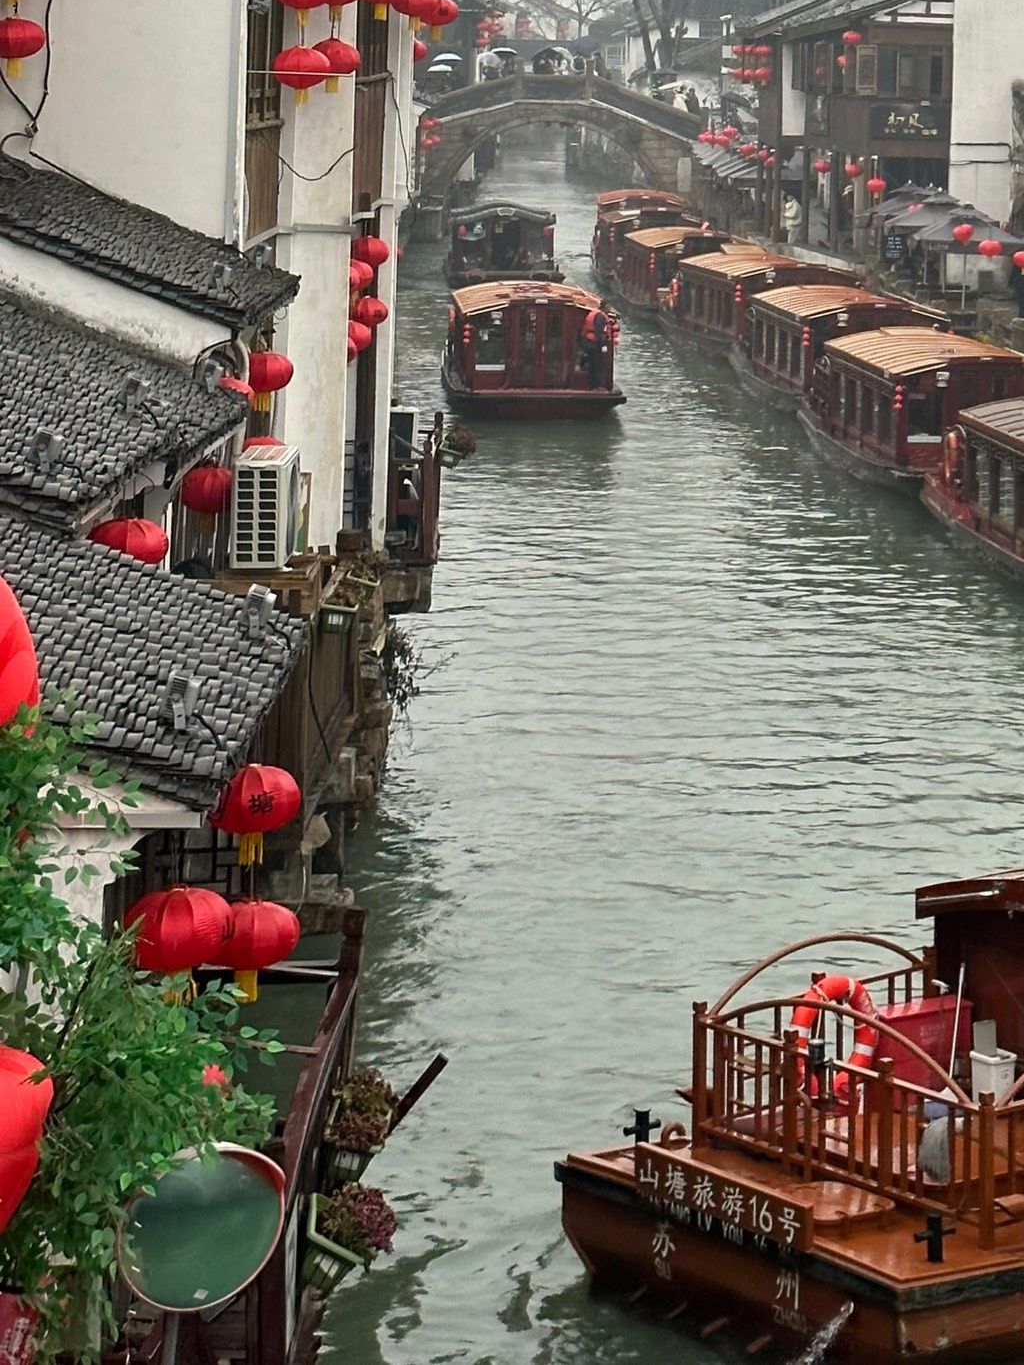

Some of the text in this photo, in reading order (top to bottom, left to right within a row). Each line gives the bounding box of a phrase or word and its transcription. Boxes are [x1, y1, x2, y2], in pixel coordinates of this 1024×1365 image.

[639, 1159, 800, 1244] 山塘旅游16号
